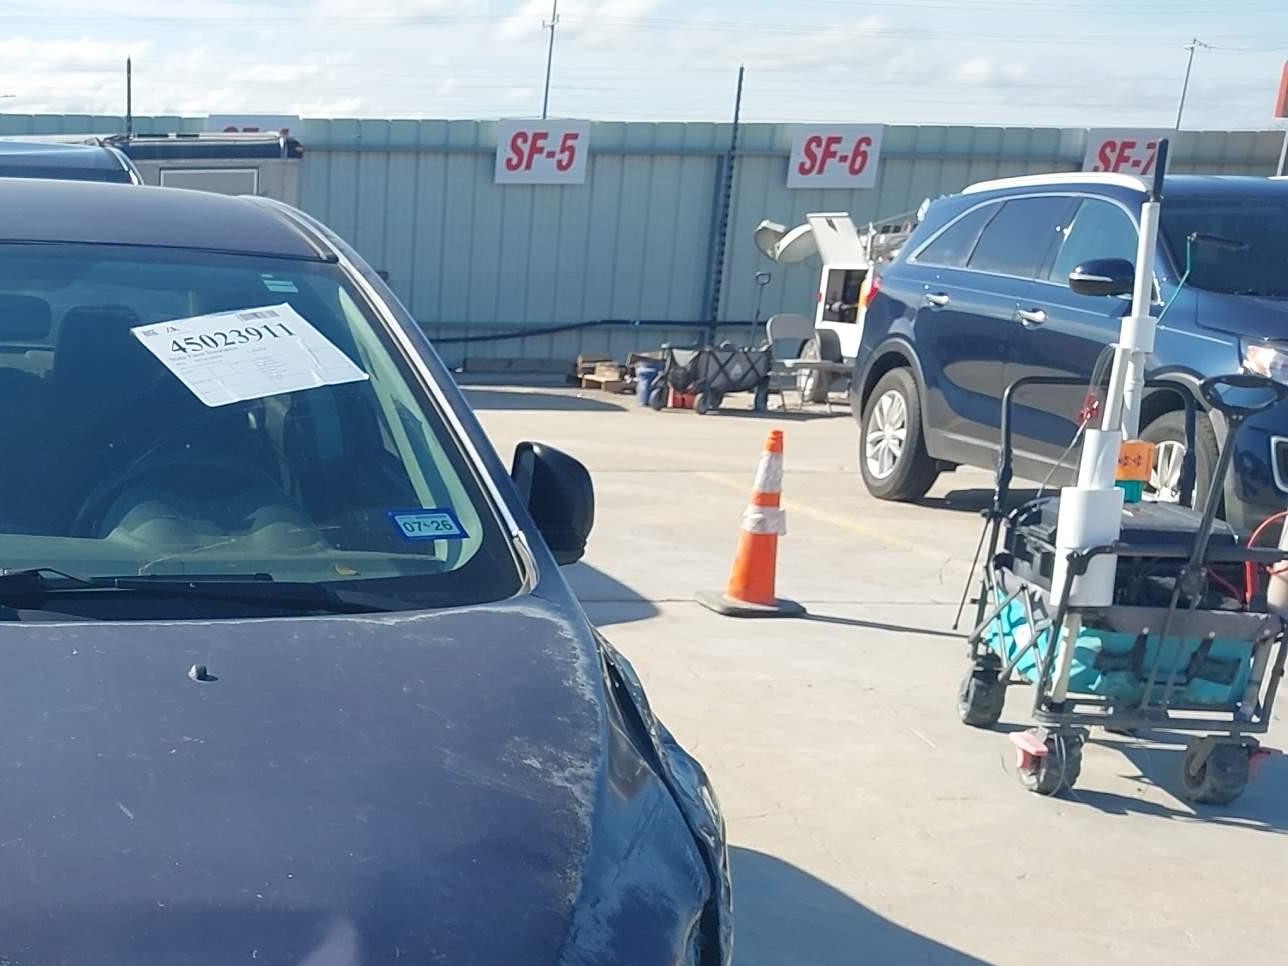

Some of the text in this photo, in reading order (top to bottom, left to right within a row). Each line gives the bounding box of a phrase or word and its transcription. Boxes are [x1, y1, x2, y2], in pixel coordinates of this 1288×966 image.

[506, 131, 579, 171] SF-5
[798, 135, 872, 176] SF-6
[1093, 140, 1157, 175] SF-7
[171, 323, 296, 353] 45023911
